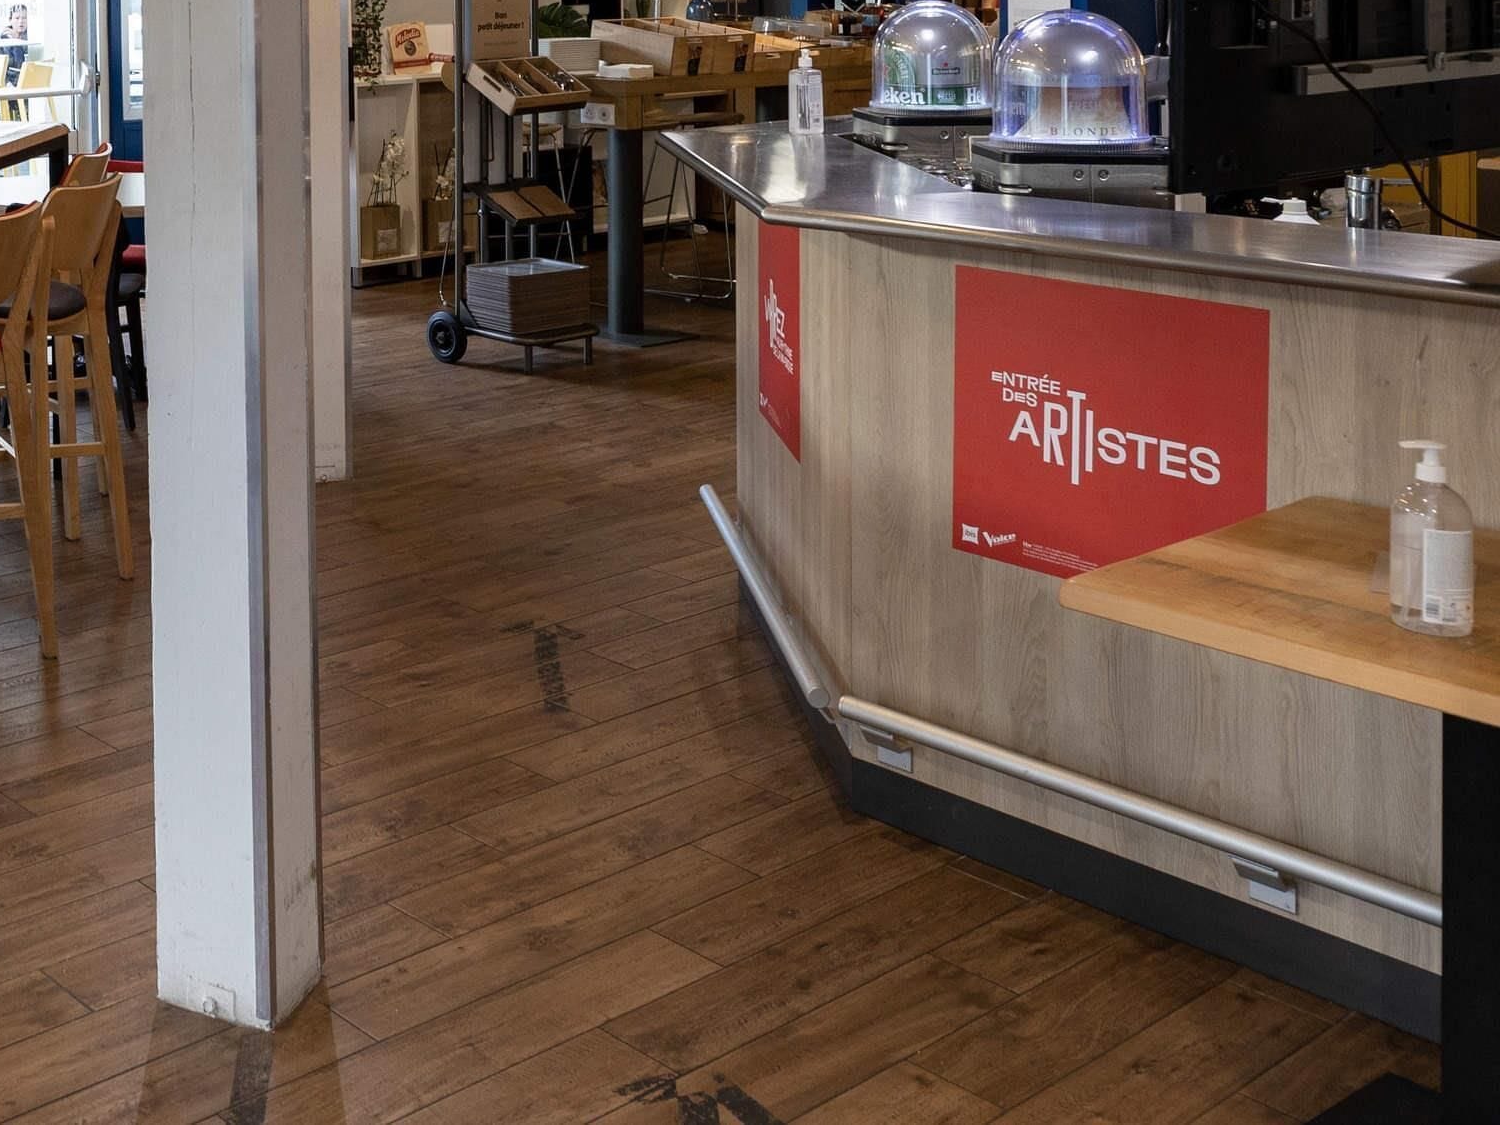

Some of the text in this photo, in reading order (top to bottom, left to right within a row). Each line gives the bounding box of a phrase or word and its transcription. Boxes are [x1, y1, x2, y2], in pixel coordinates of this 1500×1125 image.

[991, 371, 1061, 396] ENTRÉE
[1002, 387, 1038, 407] DES
[1008, 390, 1221, 486] ARTISTES
